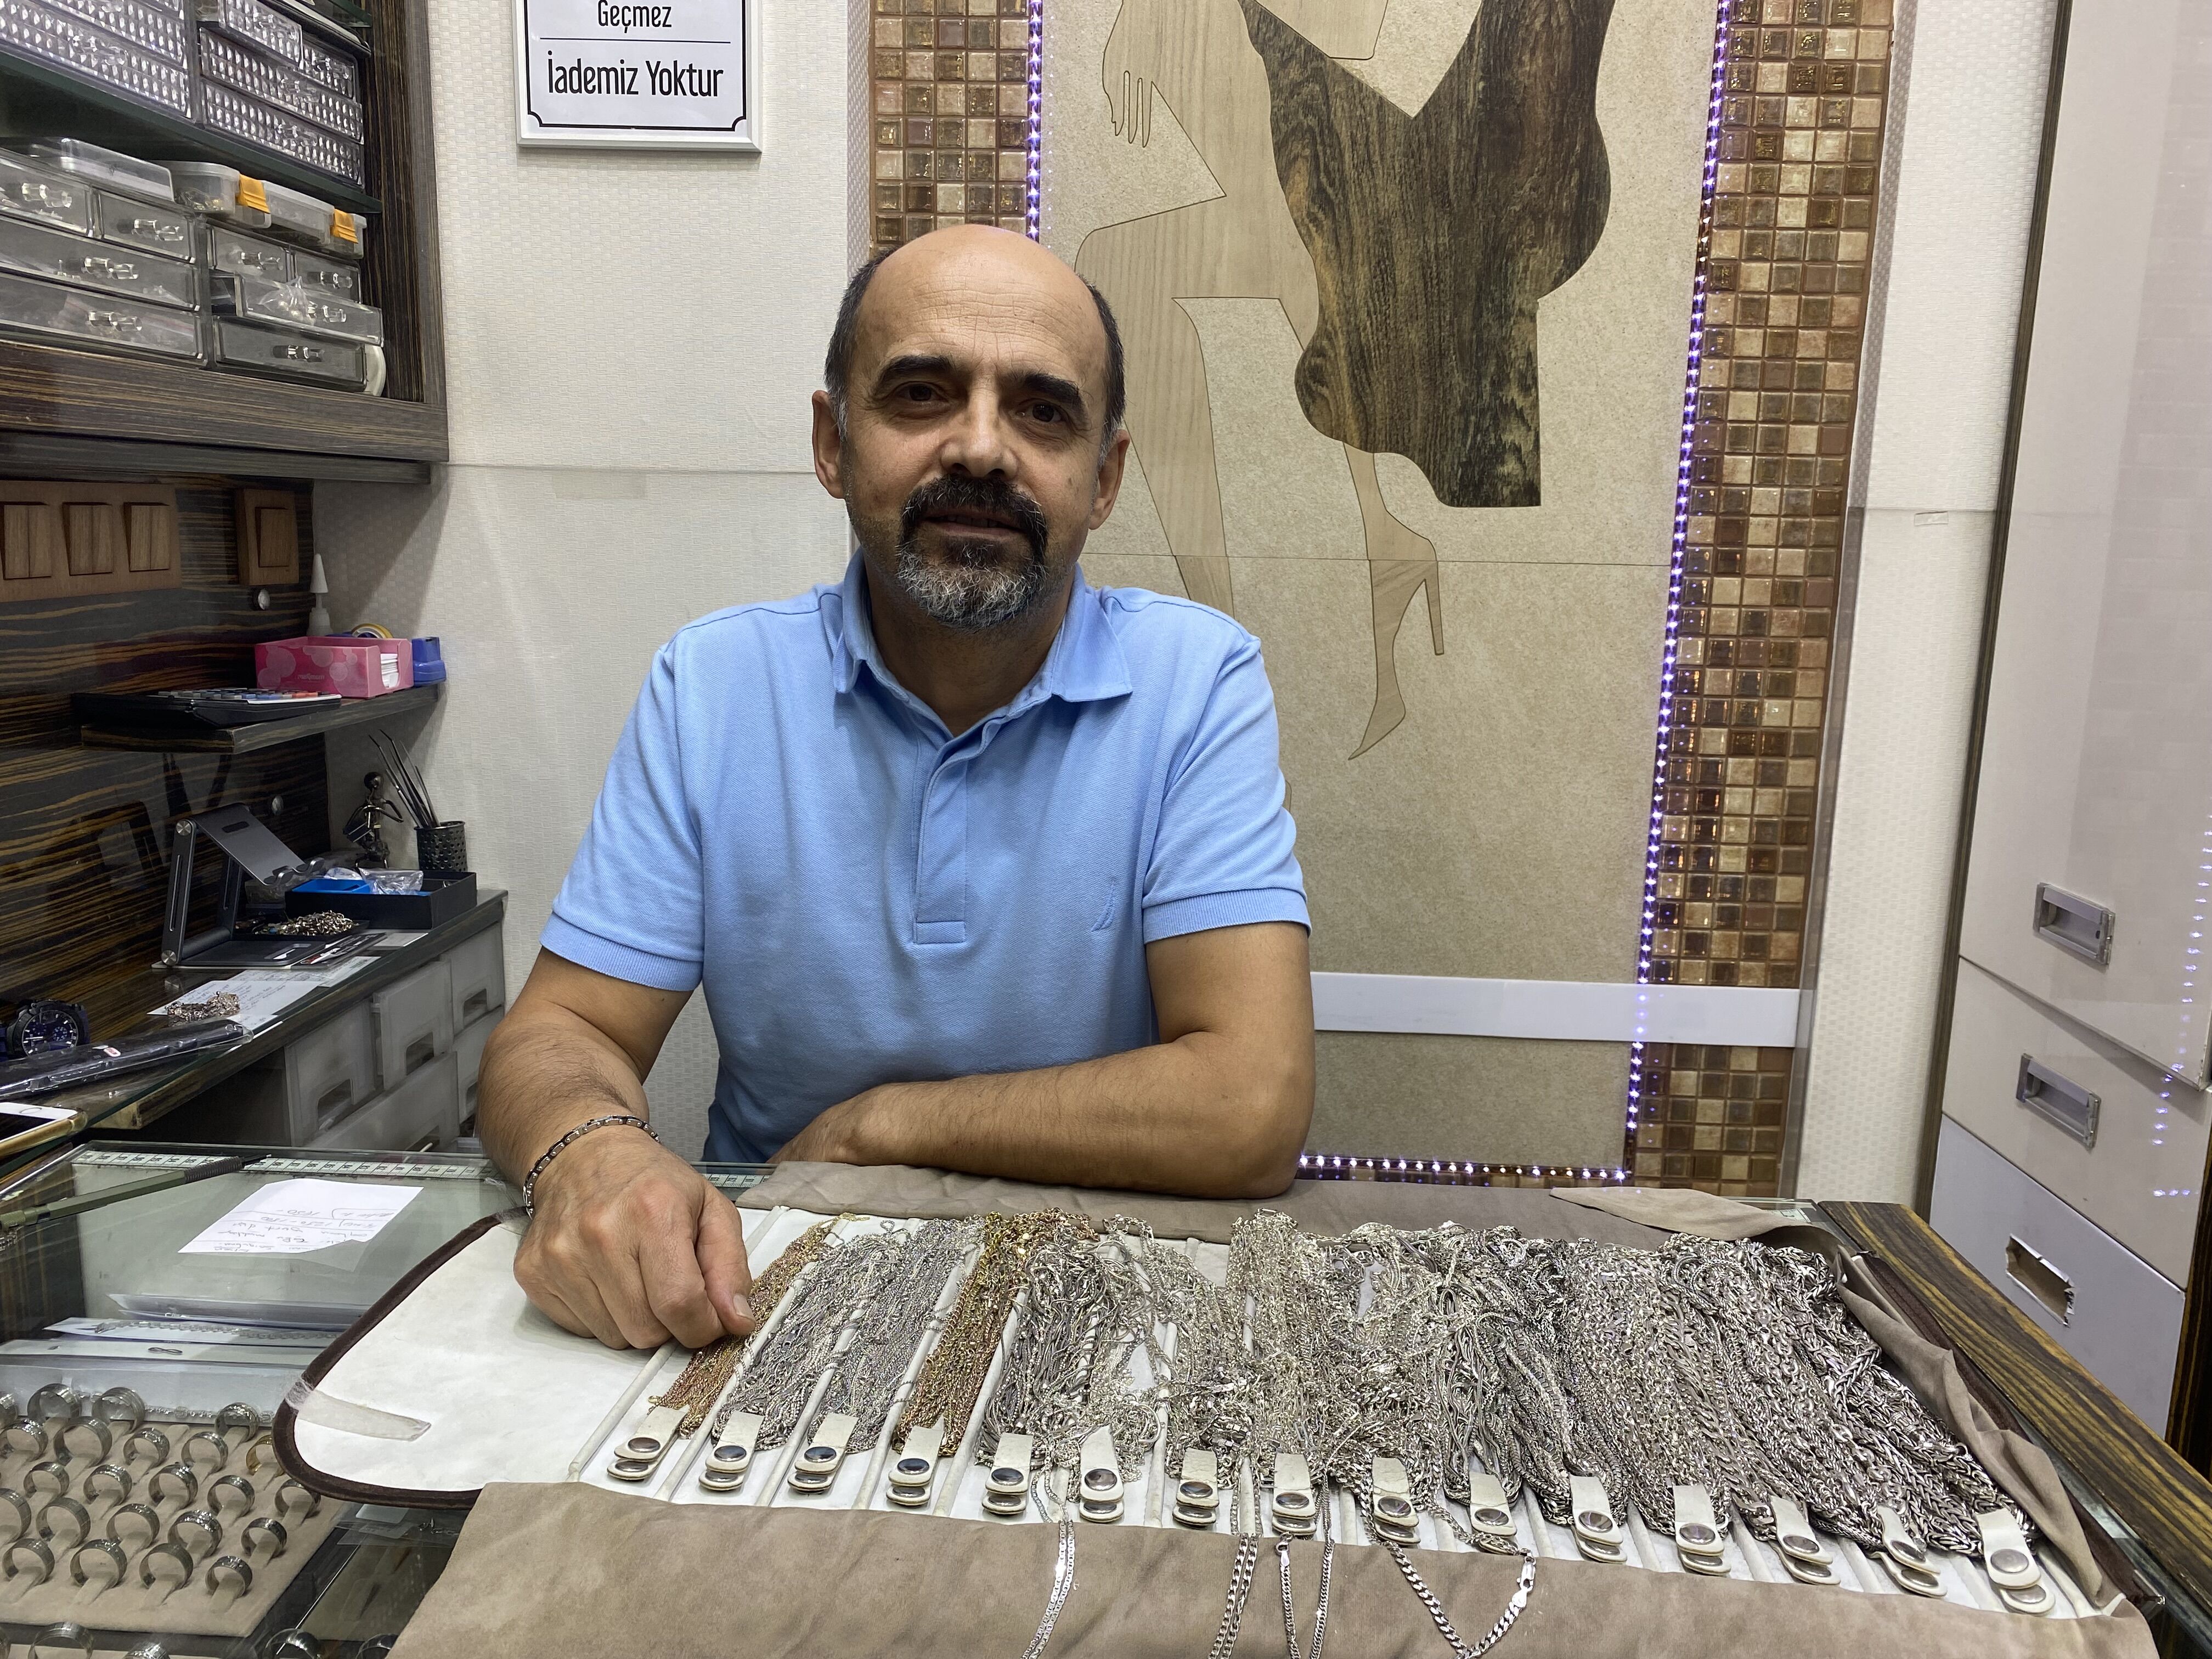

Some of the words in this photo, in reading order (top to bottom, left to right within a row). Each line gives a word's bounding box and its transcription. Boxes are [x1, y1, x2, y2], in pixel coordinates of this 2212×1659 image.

[599, 0, 672, 33] Geçmez
[548, 50, 638, 95] İademiz
[646, 60, 724, 97] Yoktur
